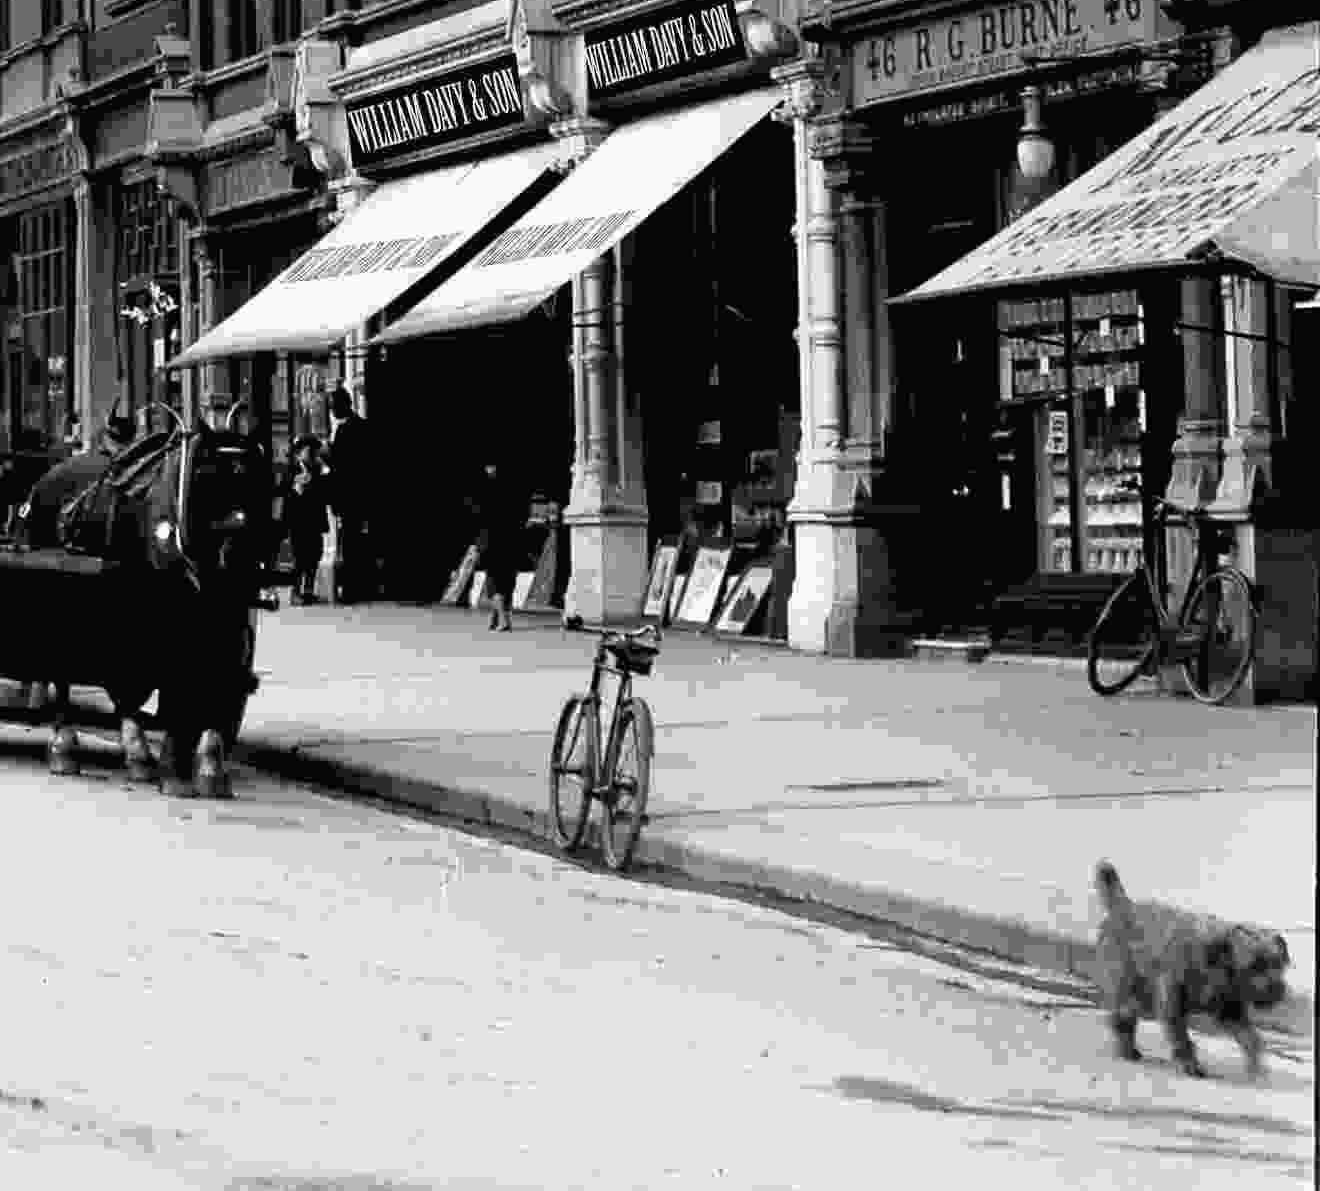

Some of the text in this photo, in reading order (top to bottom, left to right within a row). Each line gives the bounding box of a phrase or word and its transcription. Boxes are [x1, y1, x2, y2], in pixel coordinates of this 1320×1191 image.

[584, 3, 736, 90] WILLIAM DAVY & SON
[863, 34, 897, 82] 46
[347, 67, 524, 154] WILLIAM DAVY & SON
